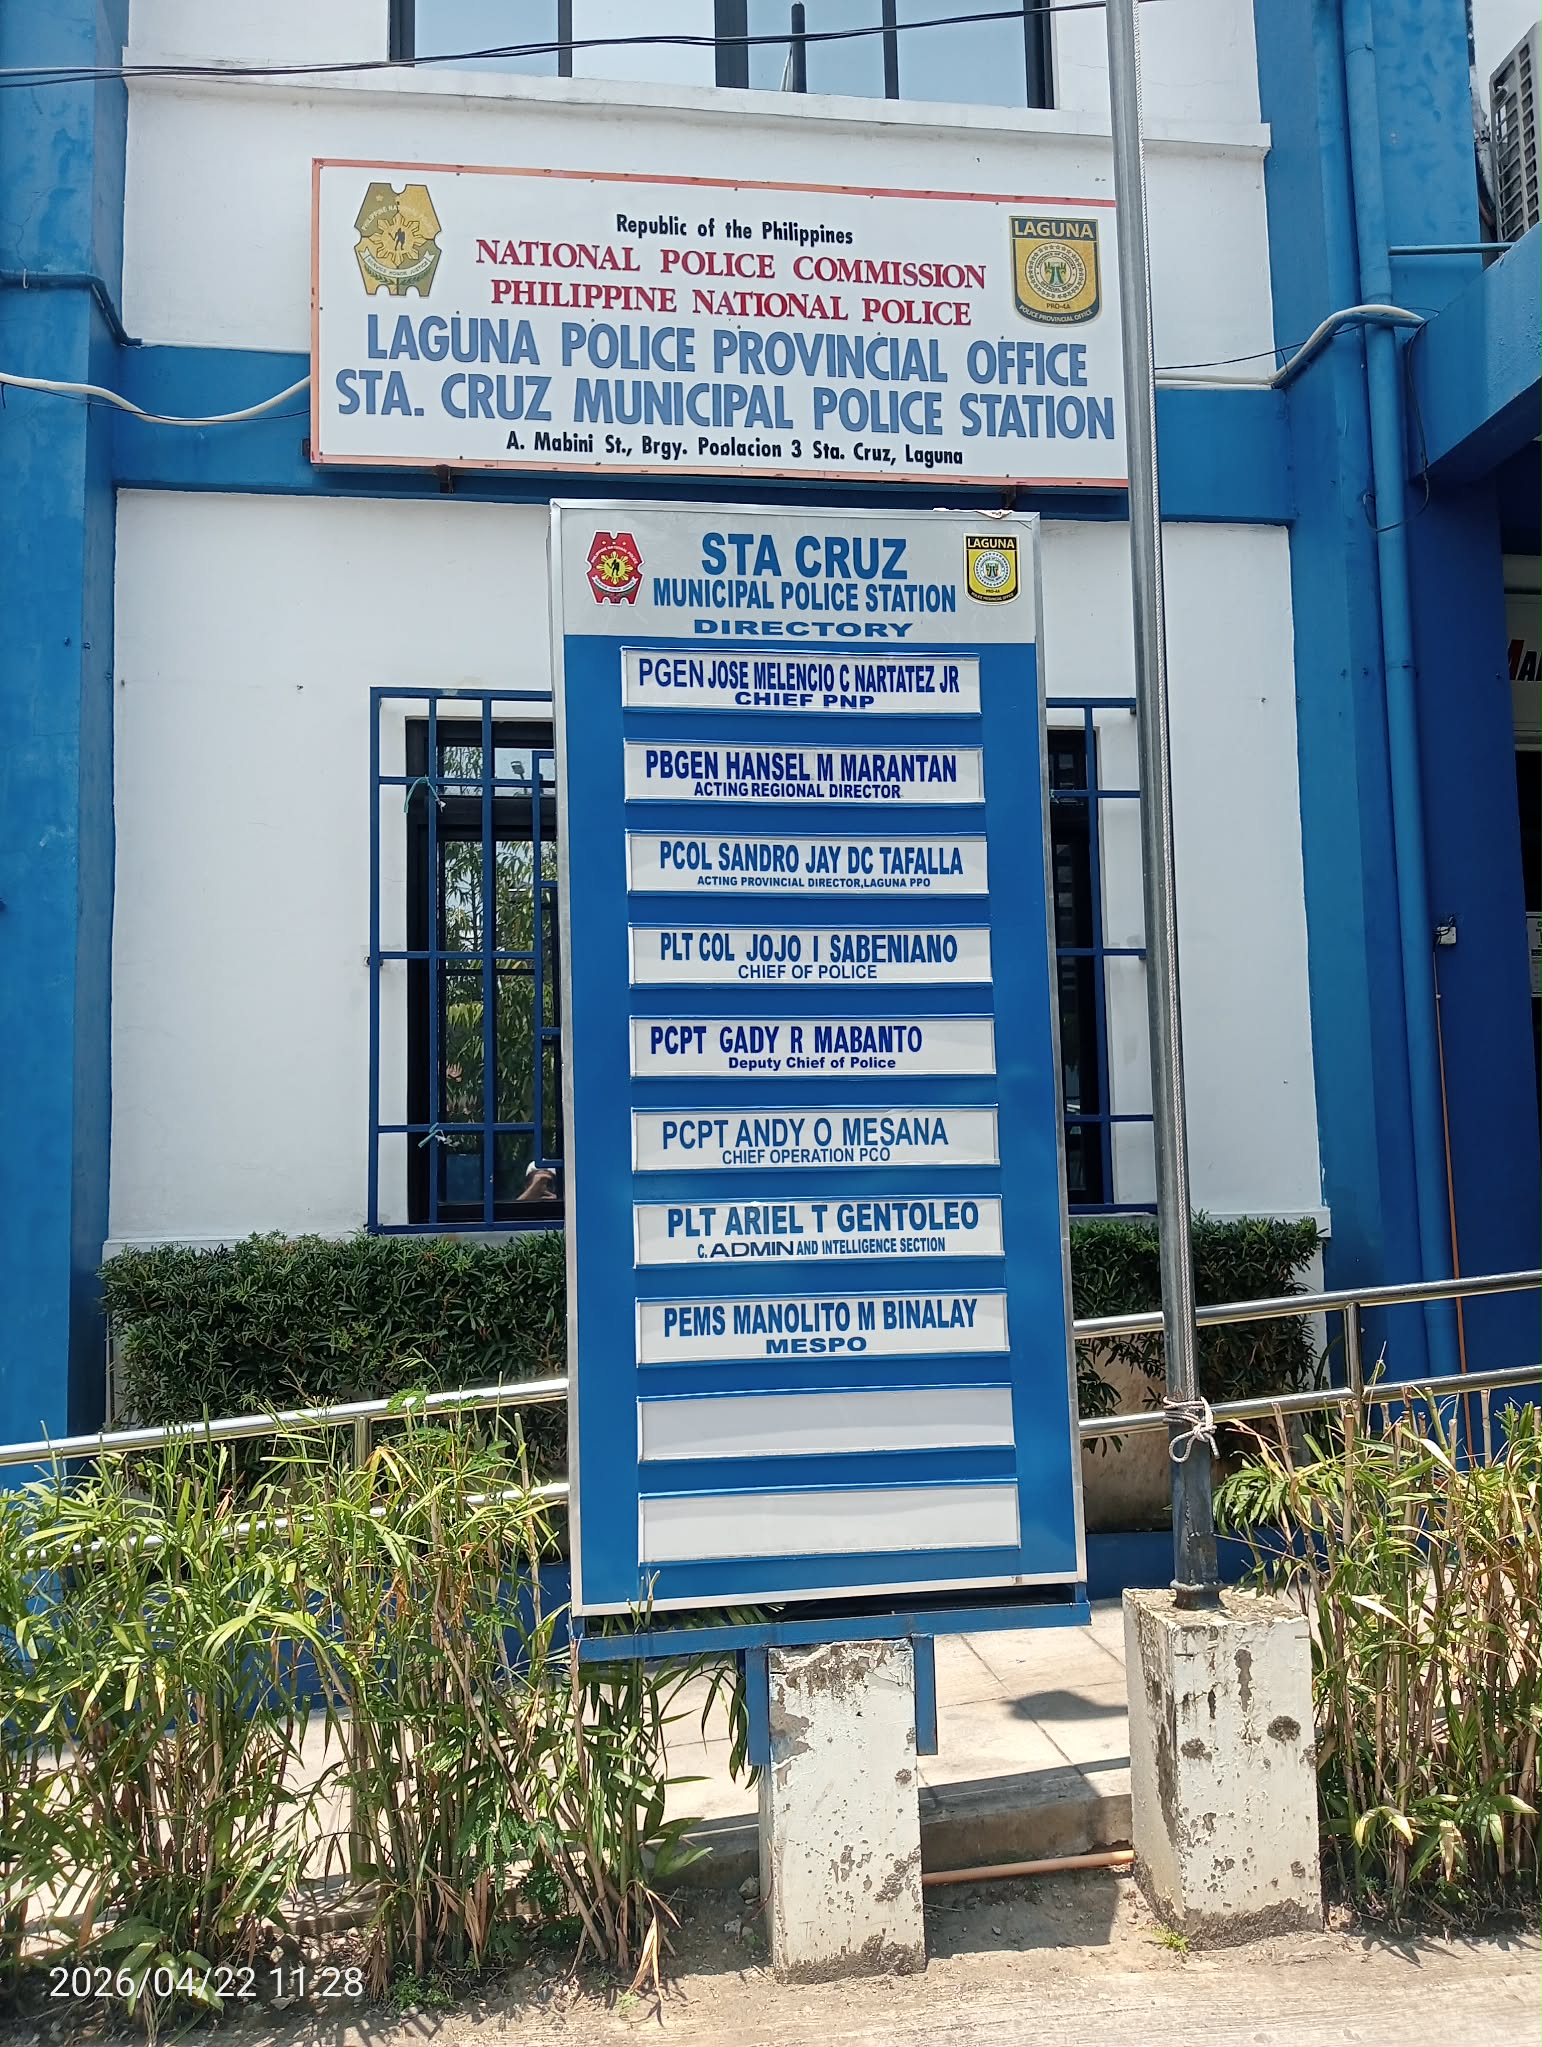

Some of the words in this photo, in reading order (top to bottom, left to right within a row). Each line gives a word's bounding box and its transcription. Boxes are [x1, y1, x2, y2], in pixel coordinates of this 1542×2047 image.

[617, 214, 686, 238] Republic
[698, 218, 714, 237] of
[726, 219, 751, 239] the
[762, 221, 852, 247] Philippines
[1014, 221, 1094, 239] LAGUNA
[476, 240, 640, 271] NATIONAL
[660, 249, 775, 278] POLICE
[793, 256, 986, 289] COMMISSION
[491, 280, 676, 312] PHILIPPINE
[692, 290, 848, 320] NATIONAL
[862, 298, 971, 325] POLICE
[368, 314, 540, 365] LAGUNA
[562, 322, 695, 372] POLICE
[714, 330, 948, 382] PROVINCIAL
[967, 340, 1087, 386] OFFICE
[336, 369, 424, 416] STA.
[441, 373, 552, 421] CRUZ
[574, 378, 793, 429] MUNICIPAL
[814, 387, 942, 435] POLICE
[960, 393, 1114, 439] STATION
[507, 431, 524, 449] A.
[535, 432, 593, 452] Mabini
[606, 435, 632, 456] St.,
[642, 436, 687, 460] Brgy.
[792, 440, 801, 457] 3
[813, 441, 844, 459] Sta.
[854, 443, 896, 465] Cruz,
[906, 444, 962, 468] Laguna
[702, 533, 781, 576] STA
[796, 536, 907, 579] CRUZ
[967, 538, 1015, 549] LAGUNA
[654, 578, 774, 609] MUNICIPAL
[782, 582, 858, 611] POLICE
[866, 584, 955, 612] STATION
[694, 620, 912, 637] DIRECTORY
[639, 659, 703, 687] PGEN
[708, 661, 748, 689] JOSE
[754, 662, 834, 691] MELENCIO
[840, 664, 849, 692] C
[855, 665, 935, 692] NARTATEZ
[940, 666, 959, 693] JR
[735, 692, 813, 706] CHIEF
[824, 695, 874, 709] PNP
[646, 750, 718, 779] PBGEN
[727, 752, 810, 781] HANSEL
[818, 754, 833, 781] M
[841, 754, 956, 782] MARANTAN
[694, 782, 748, 796] ACTING
[752, 783, 824, 797] REGIONAL
[830, 784, 900, 798] DIRECTOR
[661, 841, 712, 870] PCOL
[719, 843, 799, 872] SANDRO
[806, 846, 841, 873] JAY
[848, 847, 873, 874] DC
[880, 847, 963, 874] TAFALLA
[698, 876, 737, 885] ACTING
[741, 877, 804, 887] PROVINCIAL
[910, 878, 930, 887] PPO
[661, 933, 693, 960] PLT
[699, 933, 734, 961] COL
[746, 934, 801, 962] JOJO
[814, 936, 818, 962] I
[830, 935, 957, 962] SABENIANO
[739, 965, 786, 978] CHIEF
[792, 965, 813, 978] OF
[819, 965, 877, 978] POLICE
[651, 1026, 706, 1054] PCPT
[720, 1026, 779, 1053] GADY
[791, 1026, 802, 1053] R
[815, 1026, 922, 1053] MABANTO
[729, 1057, 781, 1071] Deputy
[787, 1057, 825, 1068] Chief
[831, 1057, 845, 1068] of
[851, 1057, 895, 1068] Police
[663, 1120, 728, 1149] PCPT
[736, 1119, 805, 1147] ANDY
[814, 1118, 831, 1146] O
[843, 1118, 948, 1146] MESANA
[723, 1149, 765, 1164] CHIEF
[770, 1148, 854, 1163] OPERATION
[860, 1147, 890, 1161] PCO
[668, 1208, 716, 1237] PLT
[725, 1206, 803, 1235] ARIEL
[812, 1205, 827, 1232] T
[837, 1202, 978, 1232] GENTOLEO
[710, 1241, 793, 1258] ADMIN
[797, 1241, 818, 1255] AND
[822, 1238, 897, 1254] INTELLIGENCE
[900, 1237, 945, 1252] SECTION
[665, 1306, 725, 1337] PEMS
[734, 1302, 850, 1334] MANOLITO
[858, 1302, 875, 1330] M
[883, 1299, 977, 1329] BINALAY
[766, 1337, 866, 1354] MESPO
